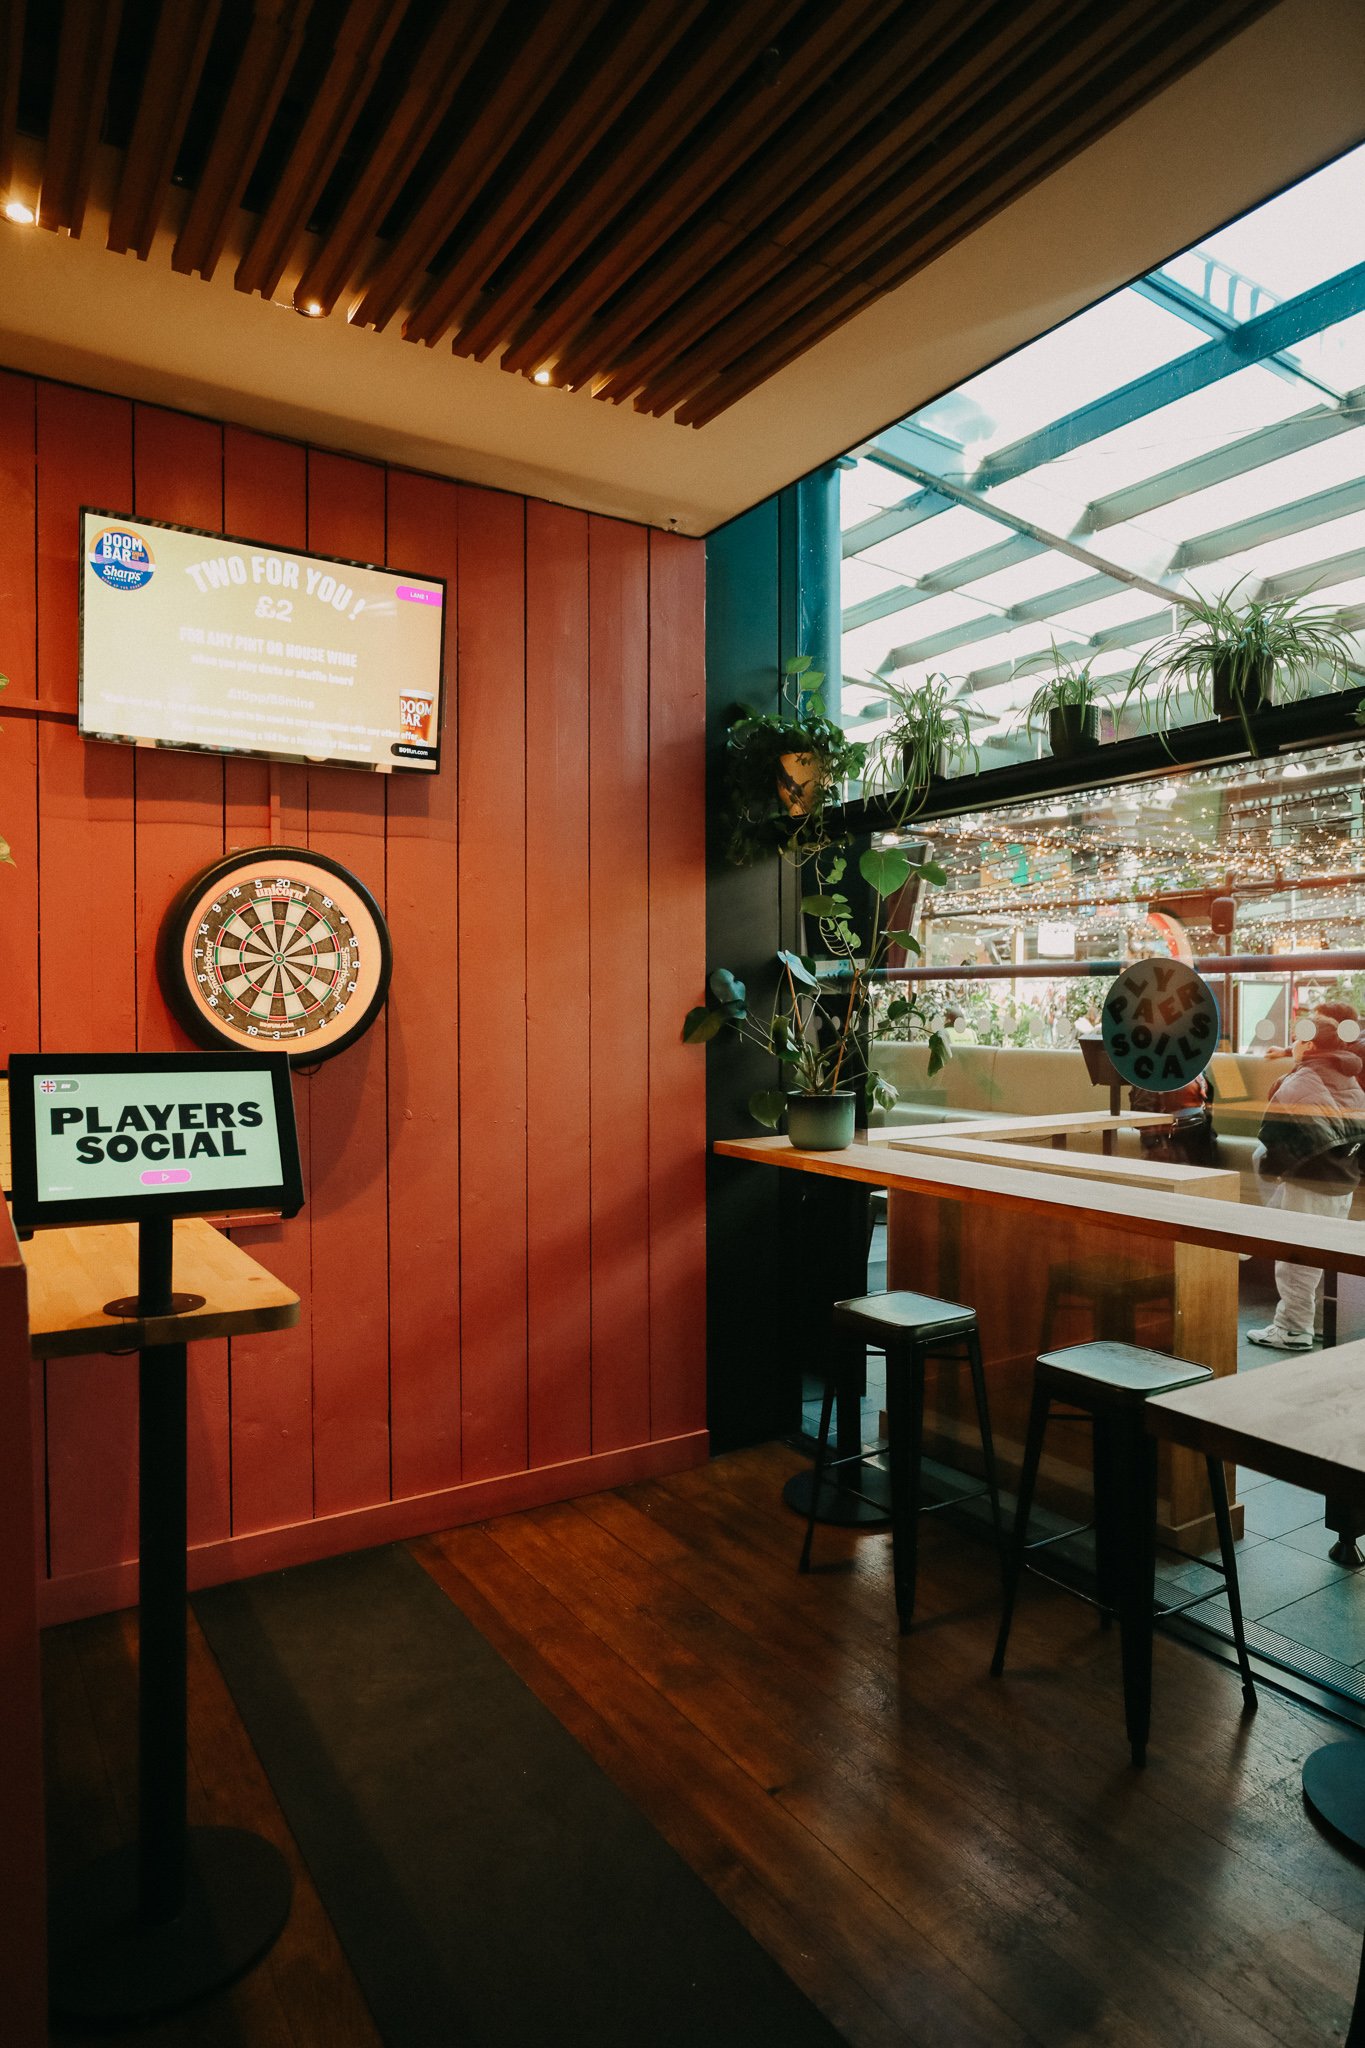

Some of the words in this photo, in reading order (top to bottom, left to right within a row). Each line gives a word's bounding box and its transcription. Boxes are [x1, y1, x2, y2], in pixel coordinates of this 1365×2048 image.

[104, 532, 142, 552] DOOM
[103, 546, 131, 562] BAR
[185, 555, 248, 593] TWO
[251, 556, 300, 590] FOR
[410, 592, 424, 600] LANE
[254, 595, 294, 622] £2
[180, 626, 204, 644] FOR
[206, 631, 233, 648] ANY
[236, 634, 264, 655] PINT
[266, 640, 283, 656] OR
[286, 643, 325, 662] HOUSE
[327, 650, 358, 668] WINE
[400, 700, 432, 716] DOOM
[254, 880, 262, 888] 5
[276, 878, 290, 888] 20
[228, 886, 242, 898] 12
[255, 884, 306, 900] unicorn
[304, 886, 310, 894] 1
[322, 896, 334, 908] 18
[212, 903, 222, 913] 9
[340, 916, 348, 924] 4
[198, 923, 210, 935] 14
[194, 948, 204, 958] 11
[204, 938, 222, 996] Smartboard
[198, 974, 206, 982] 8
[332, 947, 350, 1000] Smartboard
[346, 982, 356, 992] 10
[207, 994, 218, 1007] 16
[334, 1002, 346, 1012] 15
[226, 1014, 234, 1022] 7
[318, 1018, 327, 1028] 2
[246, 1026, 258, 1036] 19
[272, 1030, 280, 1040] 3
[296, 1027, 306, 1037] 17
[50, 1102, 264, 1135] PLAYERS
[76, 1130, 246, 1164] SOCIAL
